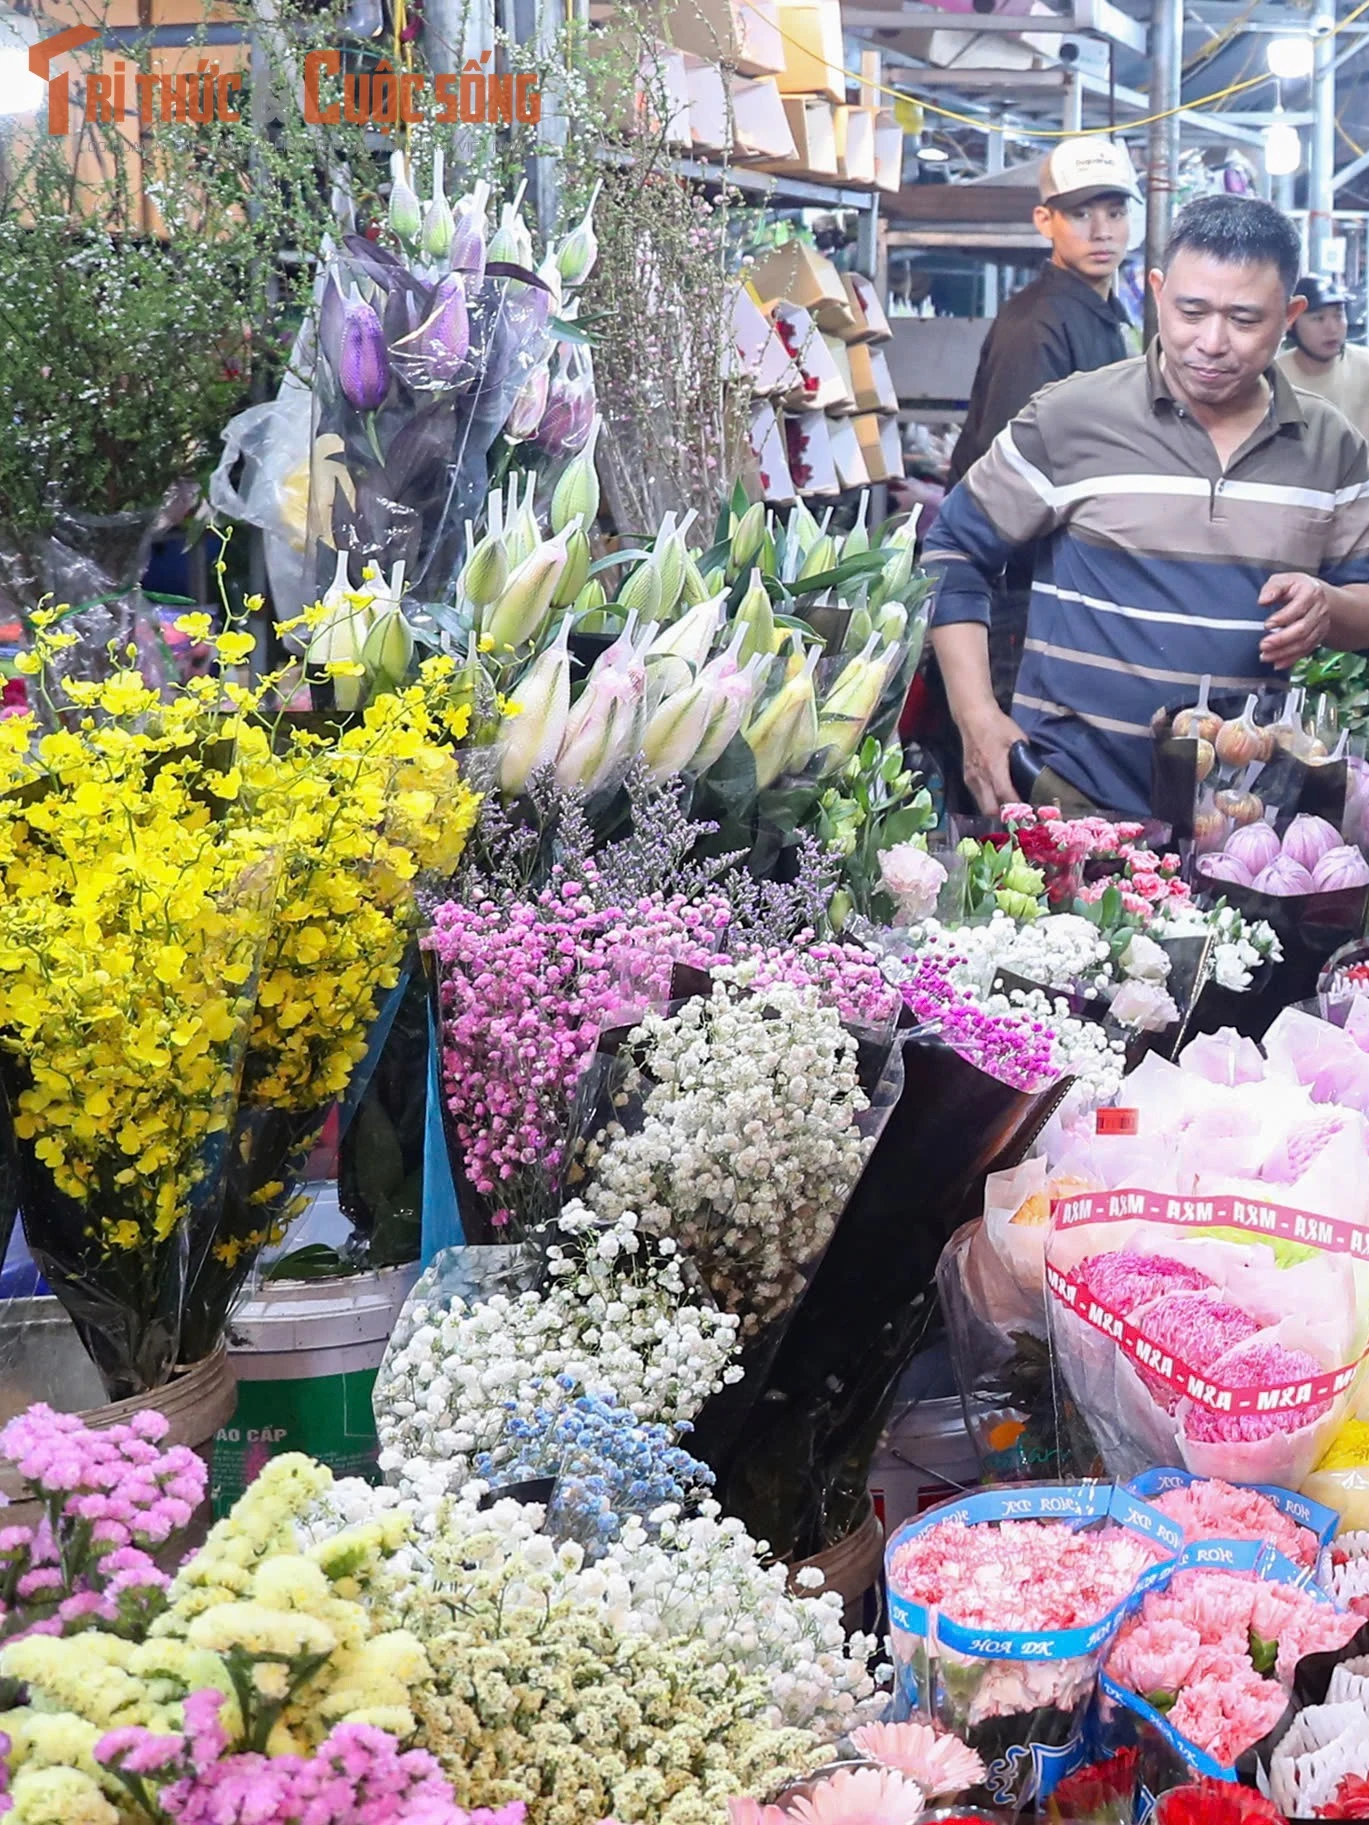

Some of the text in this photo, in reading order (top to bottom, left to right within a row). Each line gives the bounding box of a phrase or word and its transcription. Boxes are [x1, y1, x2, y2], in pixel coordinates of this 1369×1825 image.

[1088, 1301, 1124, 1341] M&A
[1135, 1338, 1173, 1378] M&A
[1187, 1375, 1232, 1411] M&A
[1256, 1383, 1312, 1411] M&A
[216, 1424, 288, 1443] AO CẤP
[969, 1638, 1013, 1653] HOA
[1020, 1640, 1054, 1657] DK
